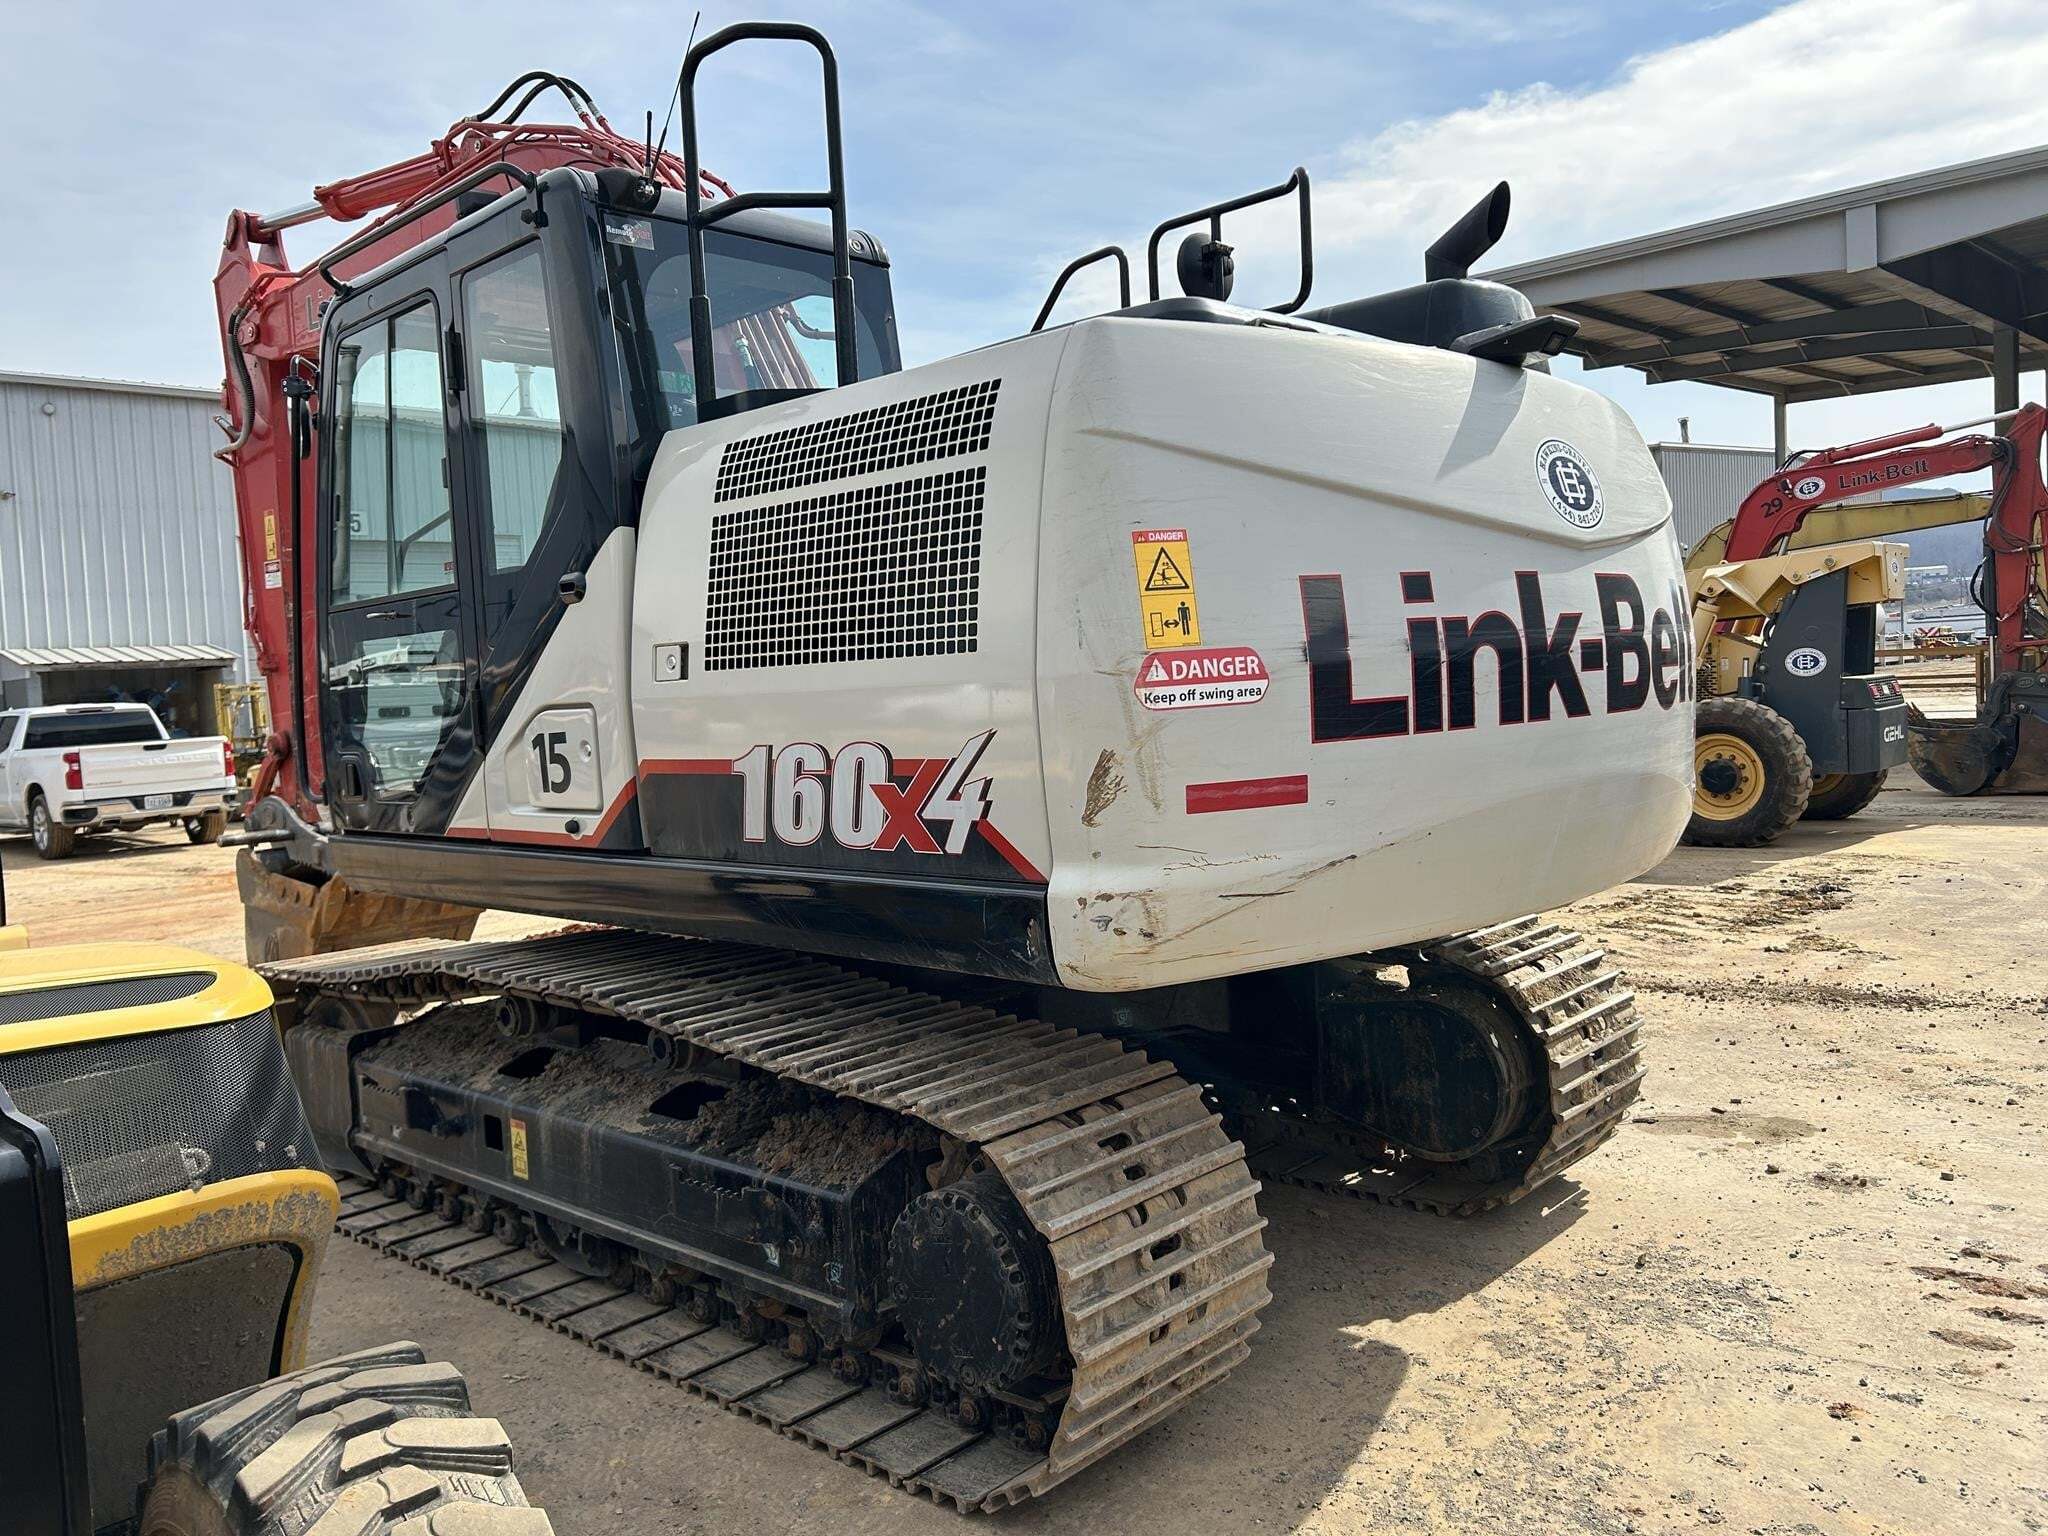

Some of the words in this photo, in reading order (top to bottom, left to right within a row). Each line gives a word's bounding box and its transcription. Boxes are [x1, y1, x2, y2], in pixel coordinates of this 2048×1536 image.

[1839, 460, 1928, 489] Link-Belt
[1761, 497, 1783, 518] 29
[1149, 531, 1184, 541] DANGER
[1171, 656, 1260, 680] DANGER
[1144, 691, 1176, 707] Keep
[1179, 689, 1197, 702] off
[1199, 686, 1234, 702] swing
[1236, 686, 1262, 698] area
[1884, 724, 1904, 742] GEHL
[531, 732, 572, 794] 15
